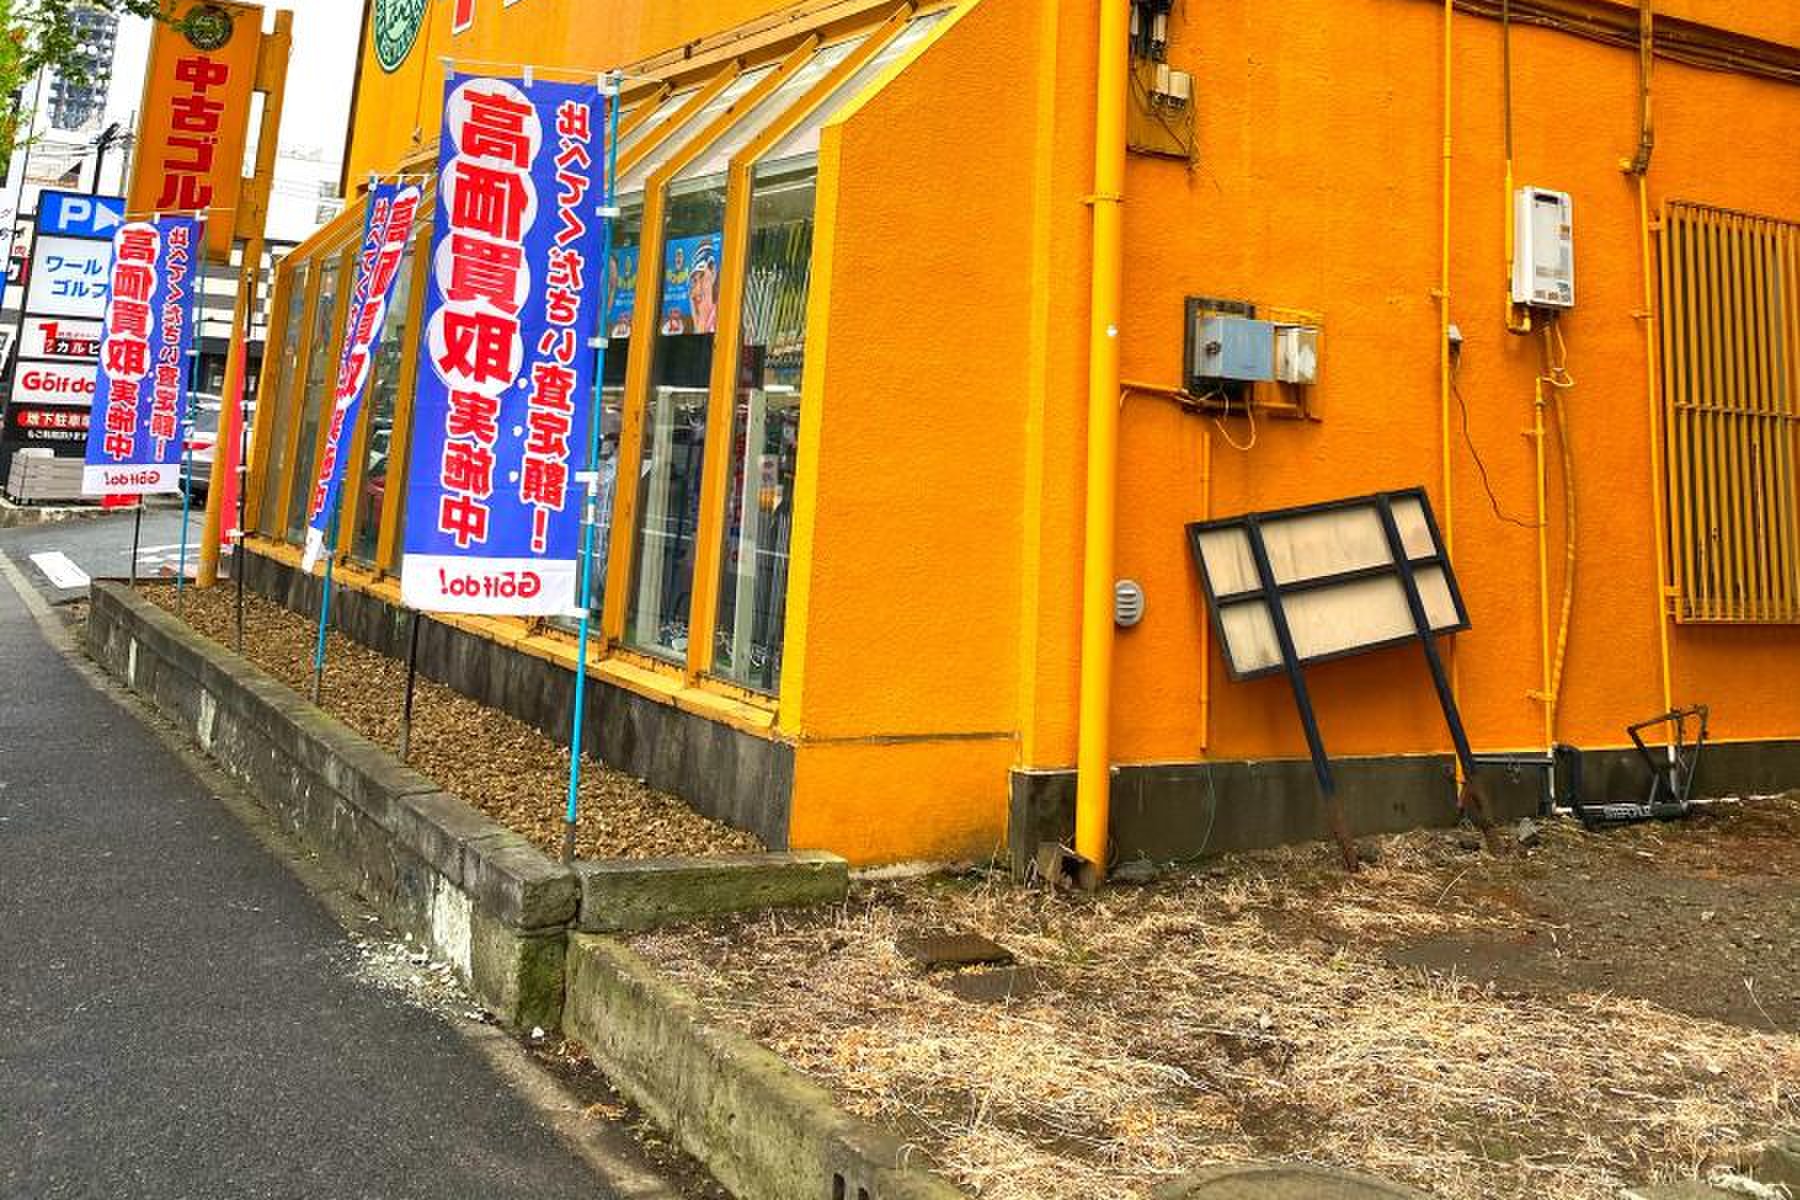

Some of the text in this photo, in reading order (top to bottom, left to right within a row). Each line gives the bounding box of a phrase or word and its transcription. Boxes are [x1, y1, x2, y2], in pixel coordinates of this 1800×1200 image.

[156, 55, 229, 210] 中古ゴル
[58, 198, 92, 230] P
